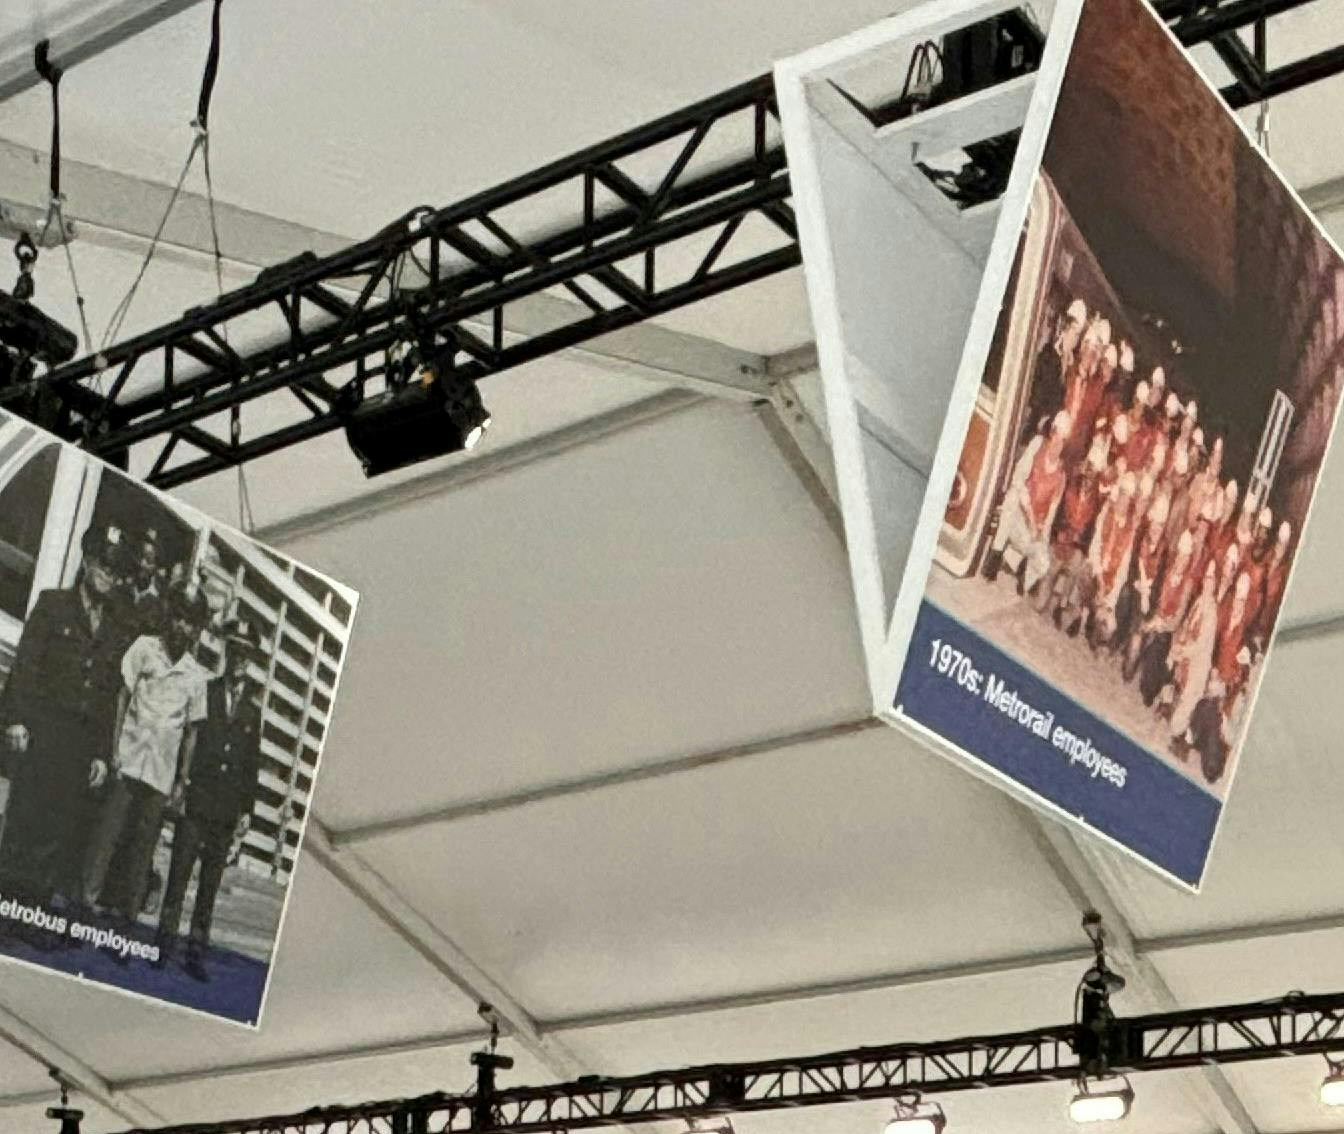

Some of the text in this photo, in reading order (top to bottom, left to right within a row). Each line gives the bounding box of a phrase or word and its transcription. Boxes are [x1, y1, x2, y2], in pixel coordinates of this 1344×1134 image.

[929, 638, 1128, 789] 1970s: Metrorail employees
[69, 921, 161, 963] employees
